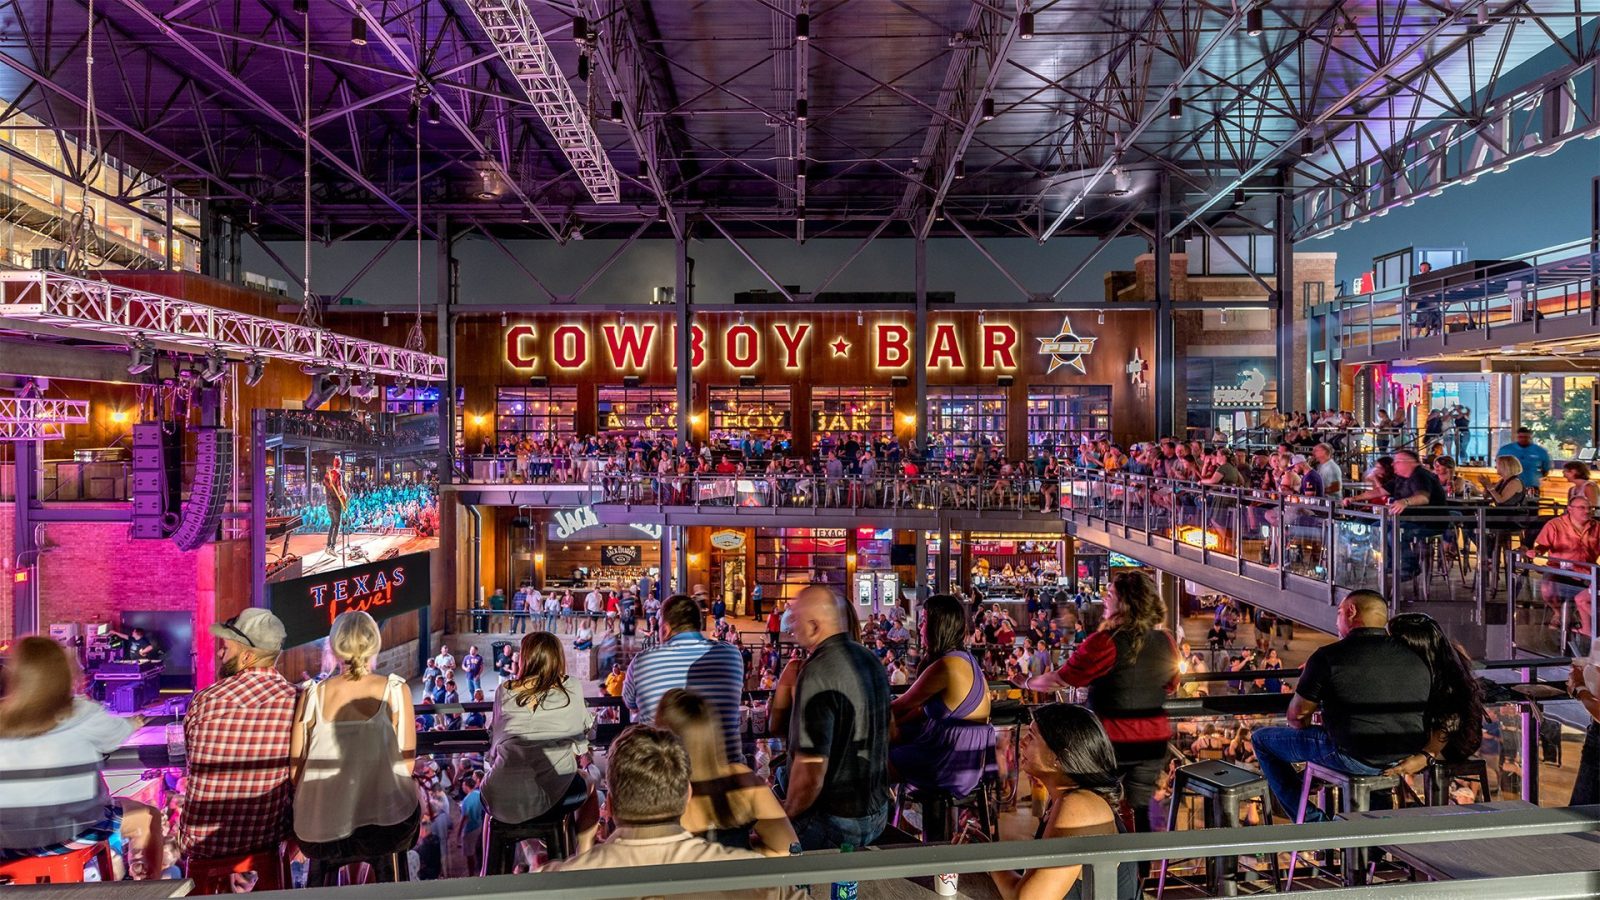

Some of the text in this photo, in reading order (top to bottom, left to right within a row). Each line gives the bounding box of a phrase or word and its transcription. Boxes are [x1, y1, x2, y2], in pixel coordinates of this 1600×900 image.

[506, 325, 1017, 368] COWBOY BAR
[1041, 343, 1092, 353] PBR
[554, 506, 599, 538] JACK
[310, 567, 405, 608] TEXAS
